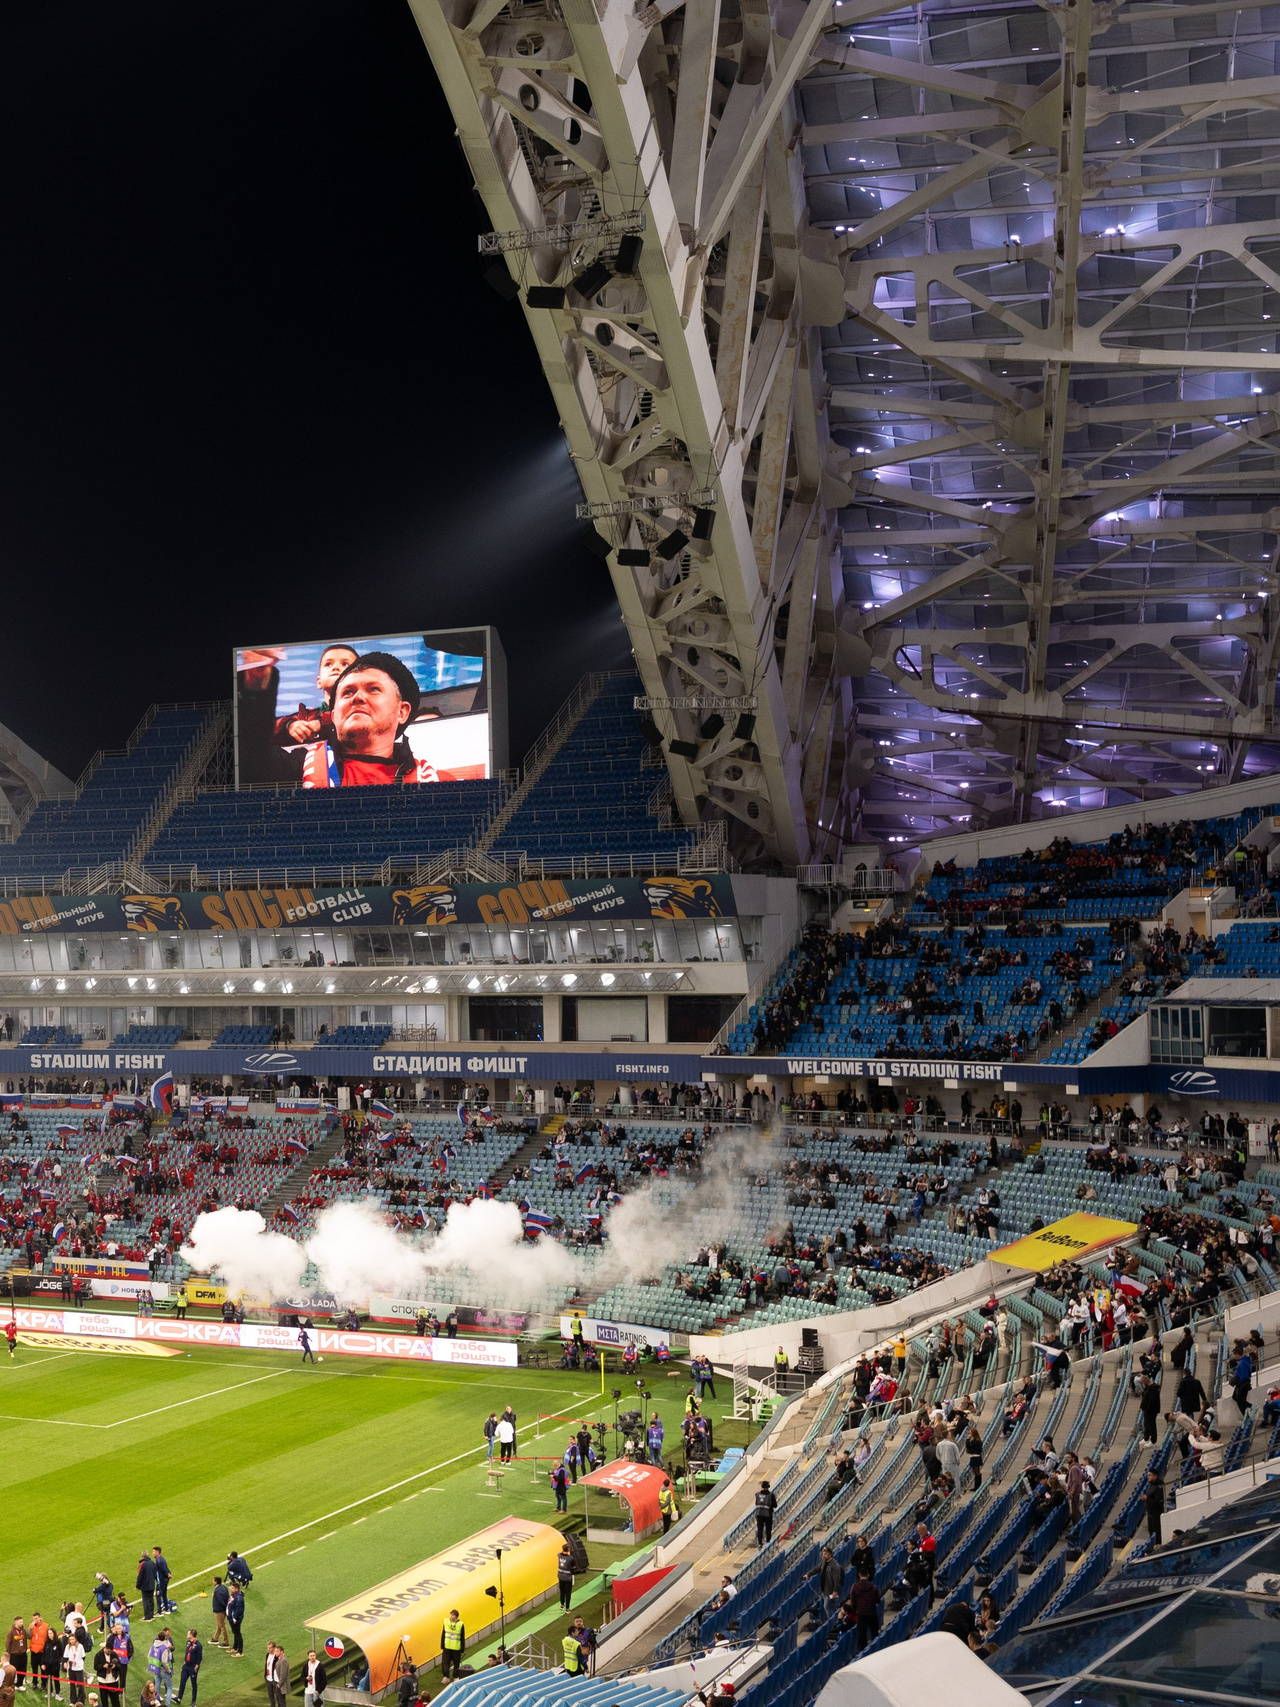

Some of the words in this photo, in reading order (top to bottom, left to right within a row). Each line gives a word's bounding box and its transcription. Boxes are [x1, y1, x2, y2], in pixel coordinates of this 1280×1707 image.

[201, 889, 322, 930] SOCHI
[286, 888, 365, 921] FOOTBALL
[477, 879, 576, 924] СОЧИ
[532, 883, 615, 919] ФУТБОЛЬНЫЙ
[592, 896, 625, 913] КЛУБ
[22, 900, 97, 931] ФУТБОЛЬНЫЙ
[76, 911, 105, 926] КЛУБ
[332, 902, 372, 923] CLUB
[30, 1054, 110, 1069] STADIUM
[115, 1054, 166, 1070] FISHT
[373, 1056, 462, 1074] СТАДИОН
[467, 1056, 528, 1074] ФИШТ
[616, 1064, 670, 1074] FISHT.INFO
[787, 1060, 864, 1076] WELCOME
[866, 1062, 886, 1076] TO
[890, 1062, 960, 1079] STADIUM
[964, 1064, 1003, 1080] FISHT
[1034, 1231, 1089, 1250] BetBoom
[94, 1263, 106, 1276] ЗА
[112, 1264, 130, 1278] НАС
[34, 1278, 62, 1290] JÖGE
[196, 1290, 216, 1298] DFM
[312, 1299, 337, 1308] LADA
[138, 1320, 238, 1344] ИСКРА
[257, 1336, 299, 1346] решат
[620, 1331, 648, 1346] RATINGS
[321, 1332, 431, 1358] ИСКРА
[441, 1530, 535, 1573] BetBoom
[1109, 1577, 1179, 1590] STADIUM
[342, 1578, 448, 1626] BetBoom
